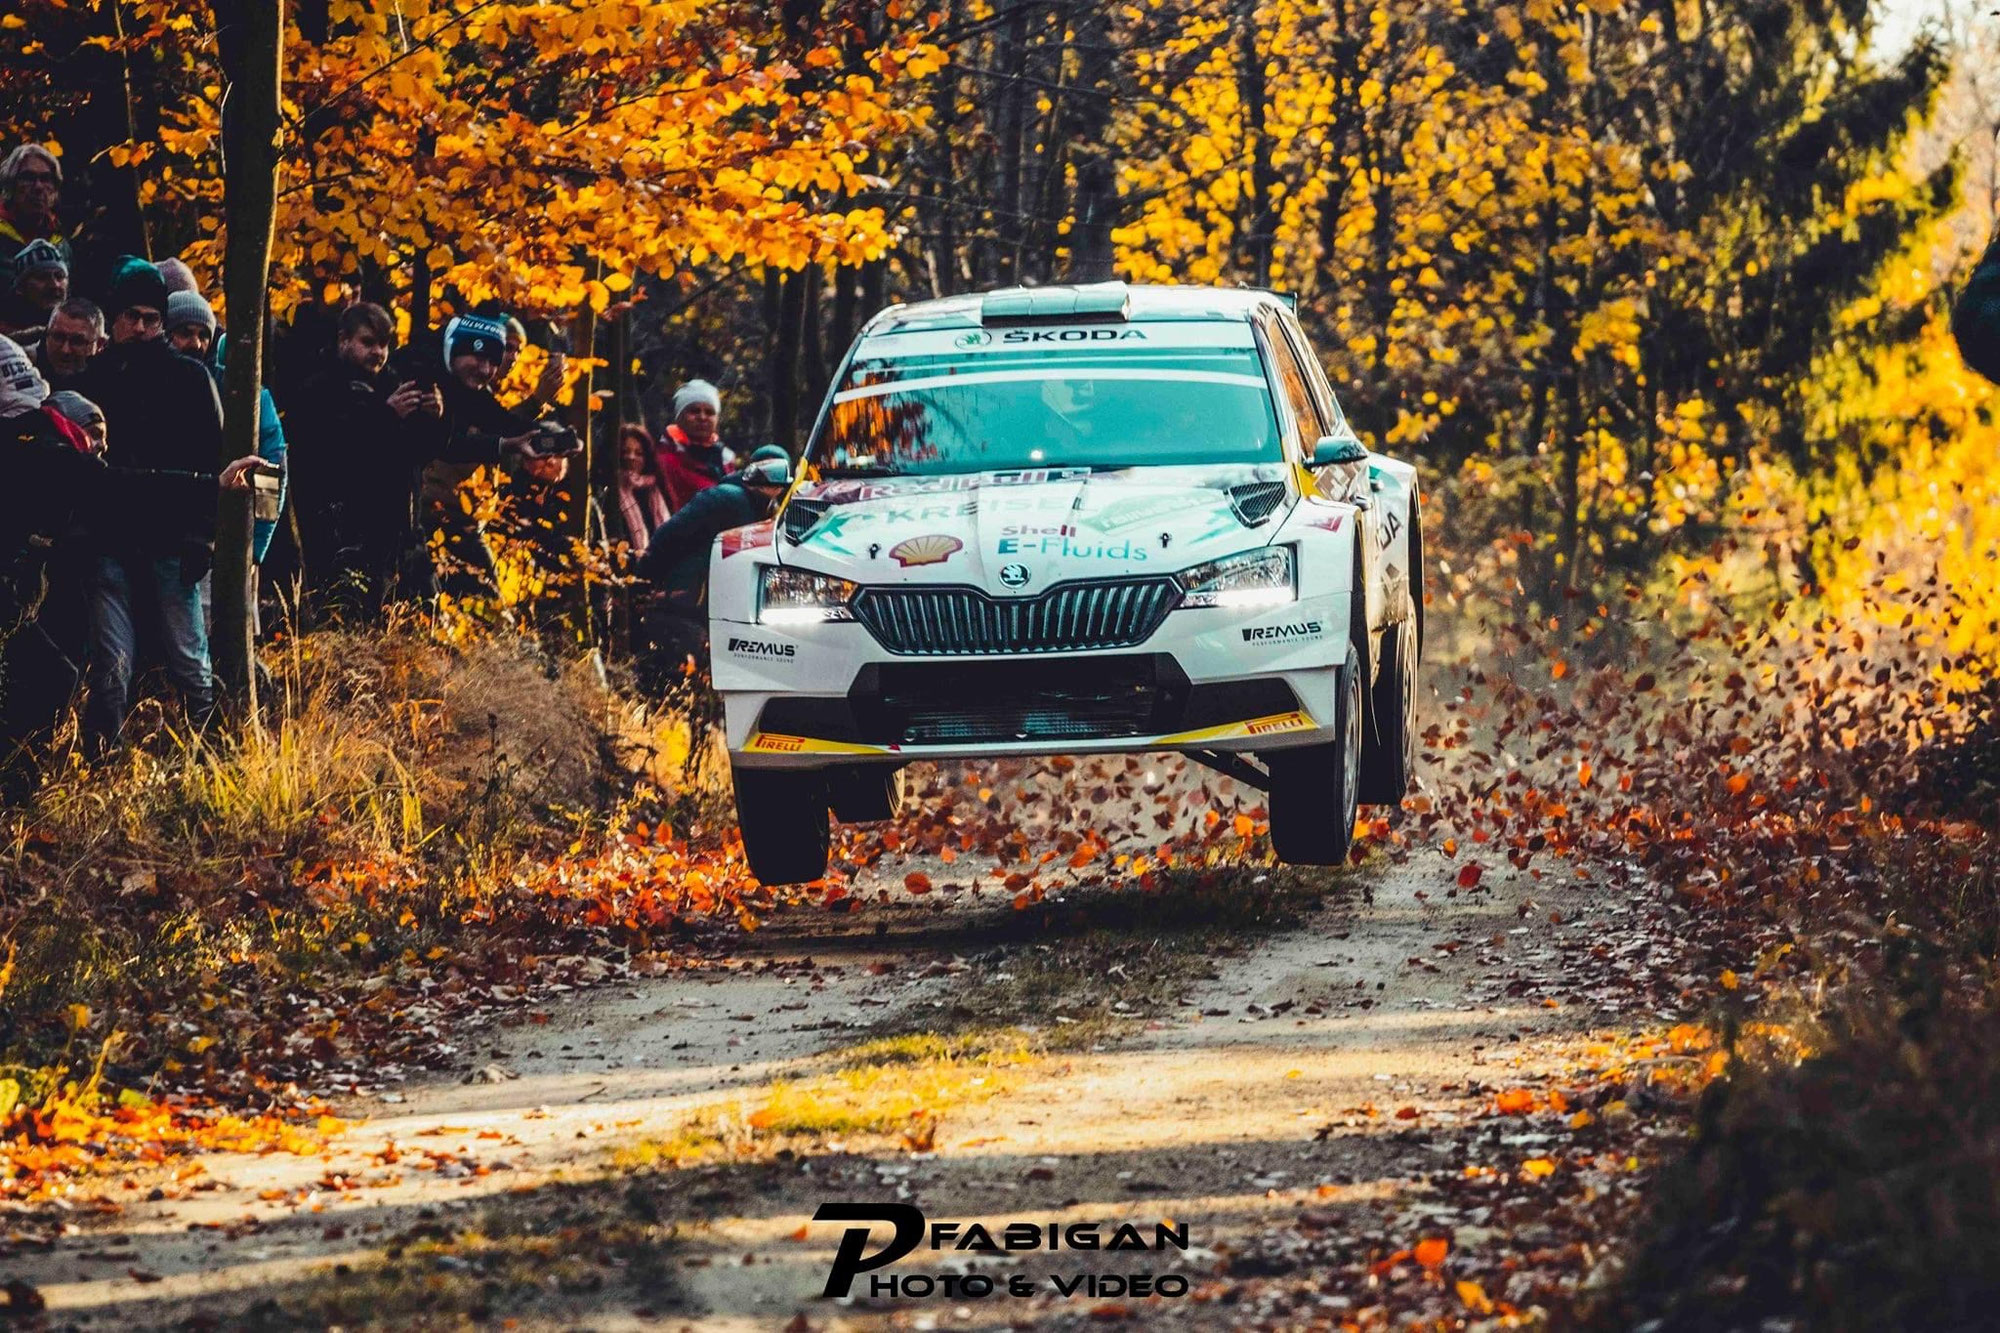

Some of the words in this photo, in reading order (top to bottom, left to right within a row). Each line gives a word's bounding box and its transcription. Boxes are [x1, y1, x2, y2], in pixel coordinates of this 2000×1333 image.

[1003, 329, 1147, 344] ŠKODA
[998, 537, 1148, 561] E-Fluids
[1251, 621, 1322, 640] REMUS
[735, 640, 795, 657] REMUS
[1245, 713, 1304, 734] PIRELLI
[755, 734, 806, 752] PIRELLI
